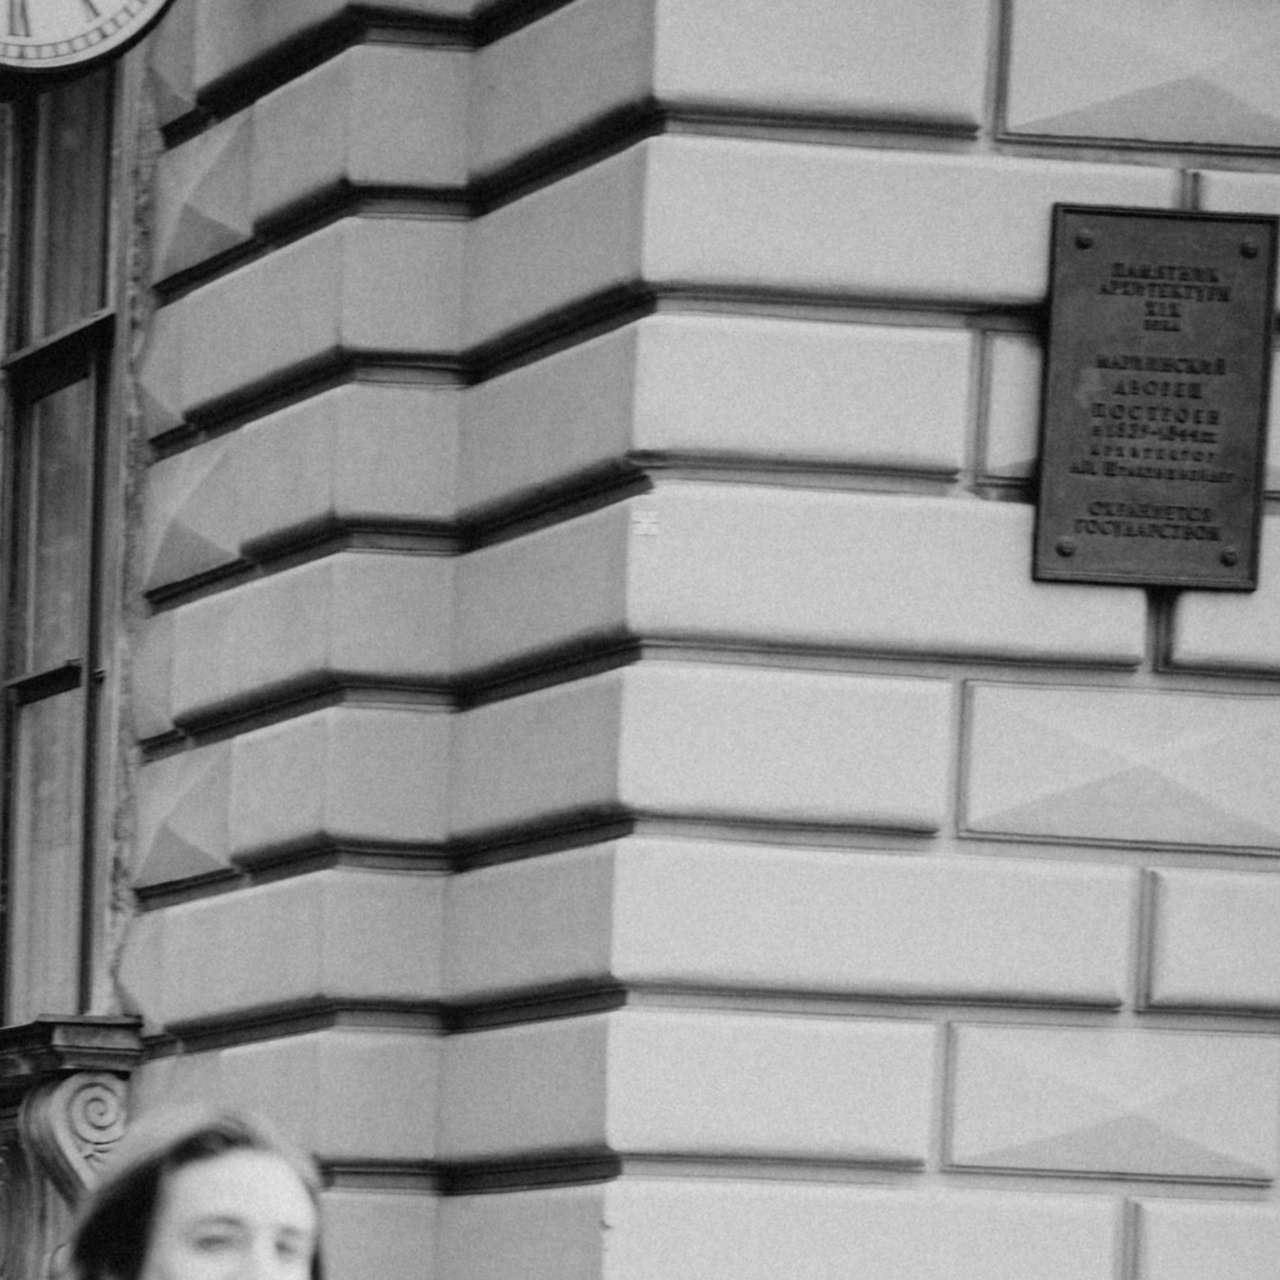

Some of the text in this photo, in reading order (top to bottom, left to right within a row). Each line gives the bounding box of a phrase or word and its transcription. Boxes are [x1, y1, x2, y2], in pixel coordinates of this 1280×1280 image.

[1112, 262, 1219, 282] ПАМЯТНИК
[1099, 281, 1231, 302] АРХИТЕКТУРЫ
[1096, 354, 1226, 375] МАРИИНСКИЙ
[1113, 380, 1202, 398] ДВОРЕЦ
[1091, 403, 1220, 424] ПОСТРОЕН
[1088, 501, 1211, 521] ОХРАНЯЕТСЯ
[1074, 519, 1221, 541] ГОСУДАРСТВОМ
